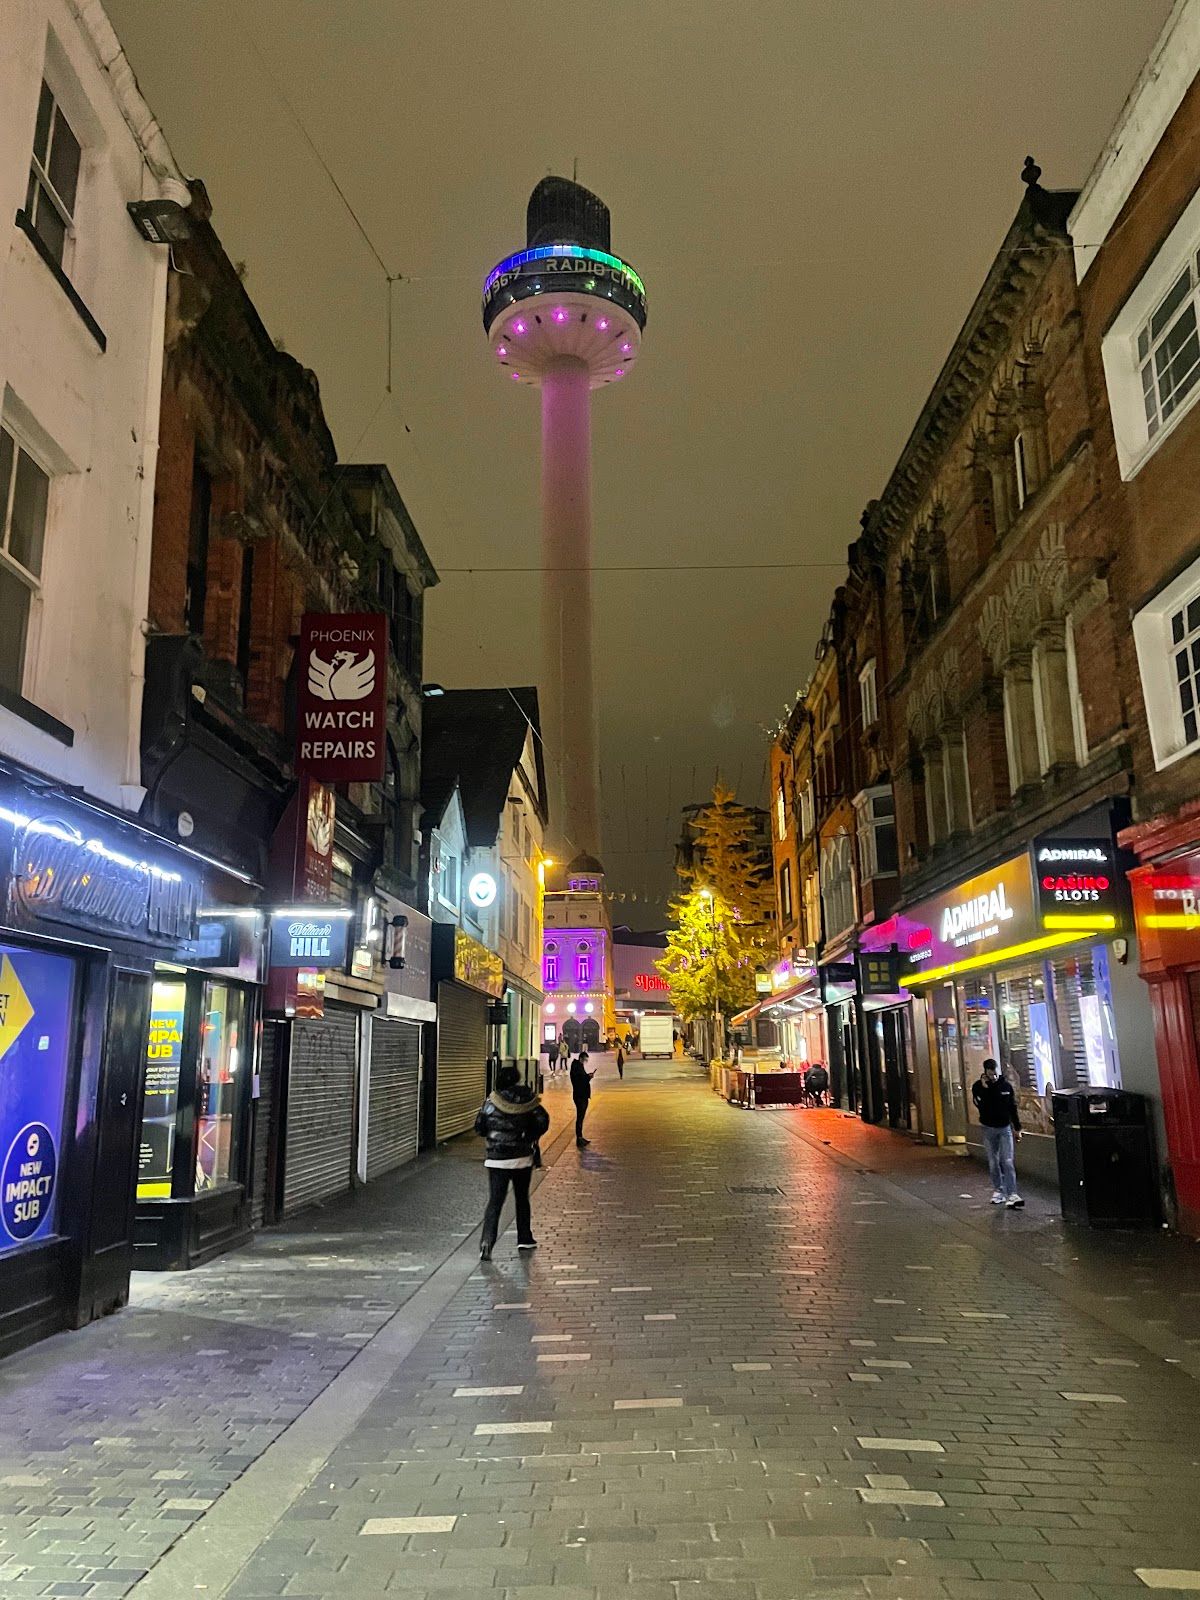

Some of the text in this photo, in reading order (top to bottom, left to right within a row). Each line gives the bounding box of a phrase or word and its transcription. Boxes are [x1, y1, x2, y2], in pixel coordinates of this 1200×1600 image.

[546, 259, 605, 276] RADIO
[310, 630, 375, 642] PHOENIX
[305, 711, 374, 729] WATCH
[301, 741, 376, 759] REPAIRS
[1039, 848, 1108, 861] ADMIRAL
[1043, 876, 1109, 890] CASINO
[1055, 889, 1100, 901] SLOTS
[941, 882, 1014, 943] ADMIRAL
[290, 938, 330, 957] HILL
[150, 1019, 177, 1029] NEW
[147, 1044, 173, 1059] UB
[20, 1160, 43, 1178] NEW
[5, 1175, 52, 1204] IMPACT
[13, 1199, 40, 1224] SUB
